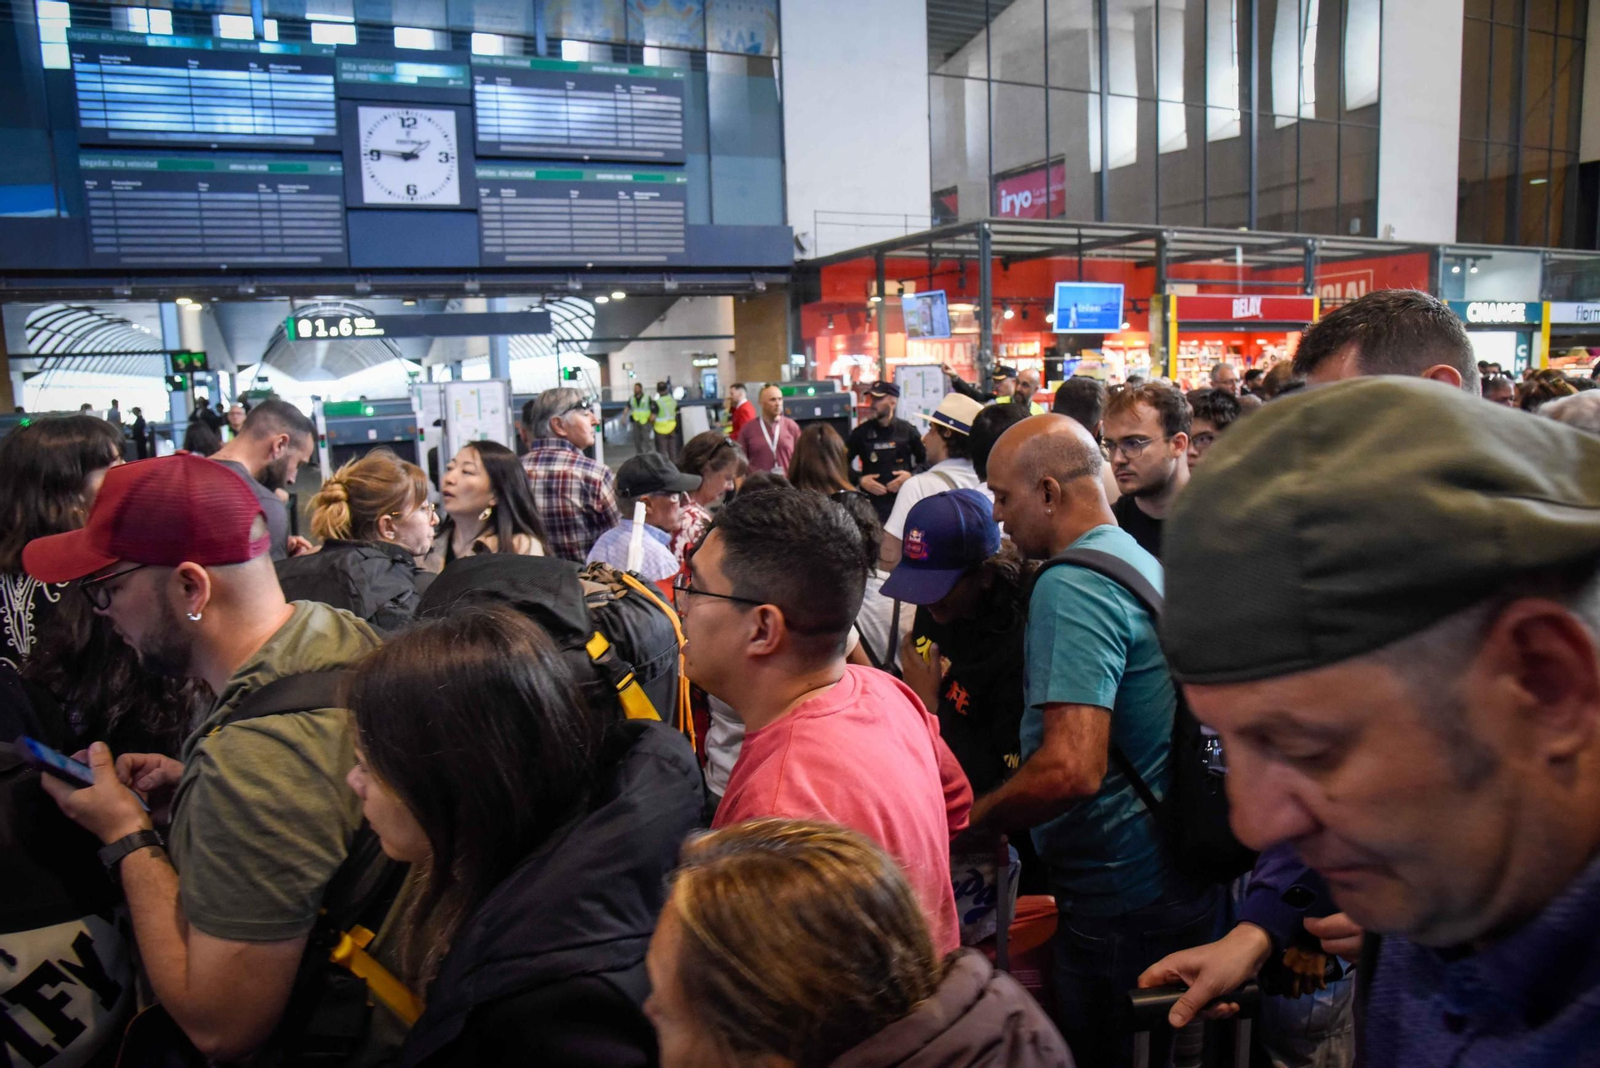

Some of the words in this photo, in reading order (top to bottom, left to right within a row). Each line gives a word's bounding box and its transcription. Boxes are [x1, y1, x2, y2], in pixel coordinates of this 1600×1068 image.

[341, 62, 357, 71] Alta
[358, 63, 394, 73] velocidad
[399, 116, 418, 129] 12
[369, 149, 381, 161] 9
[438, 151, 450, 164] 3
[406, 184, 418, 196] 6
[1001, 189, 1032, 217] iryo
[1232, 295, 1263, 319] RELAY
[1466, 302, 1526, 323] CHANGE
